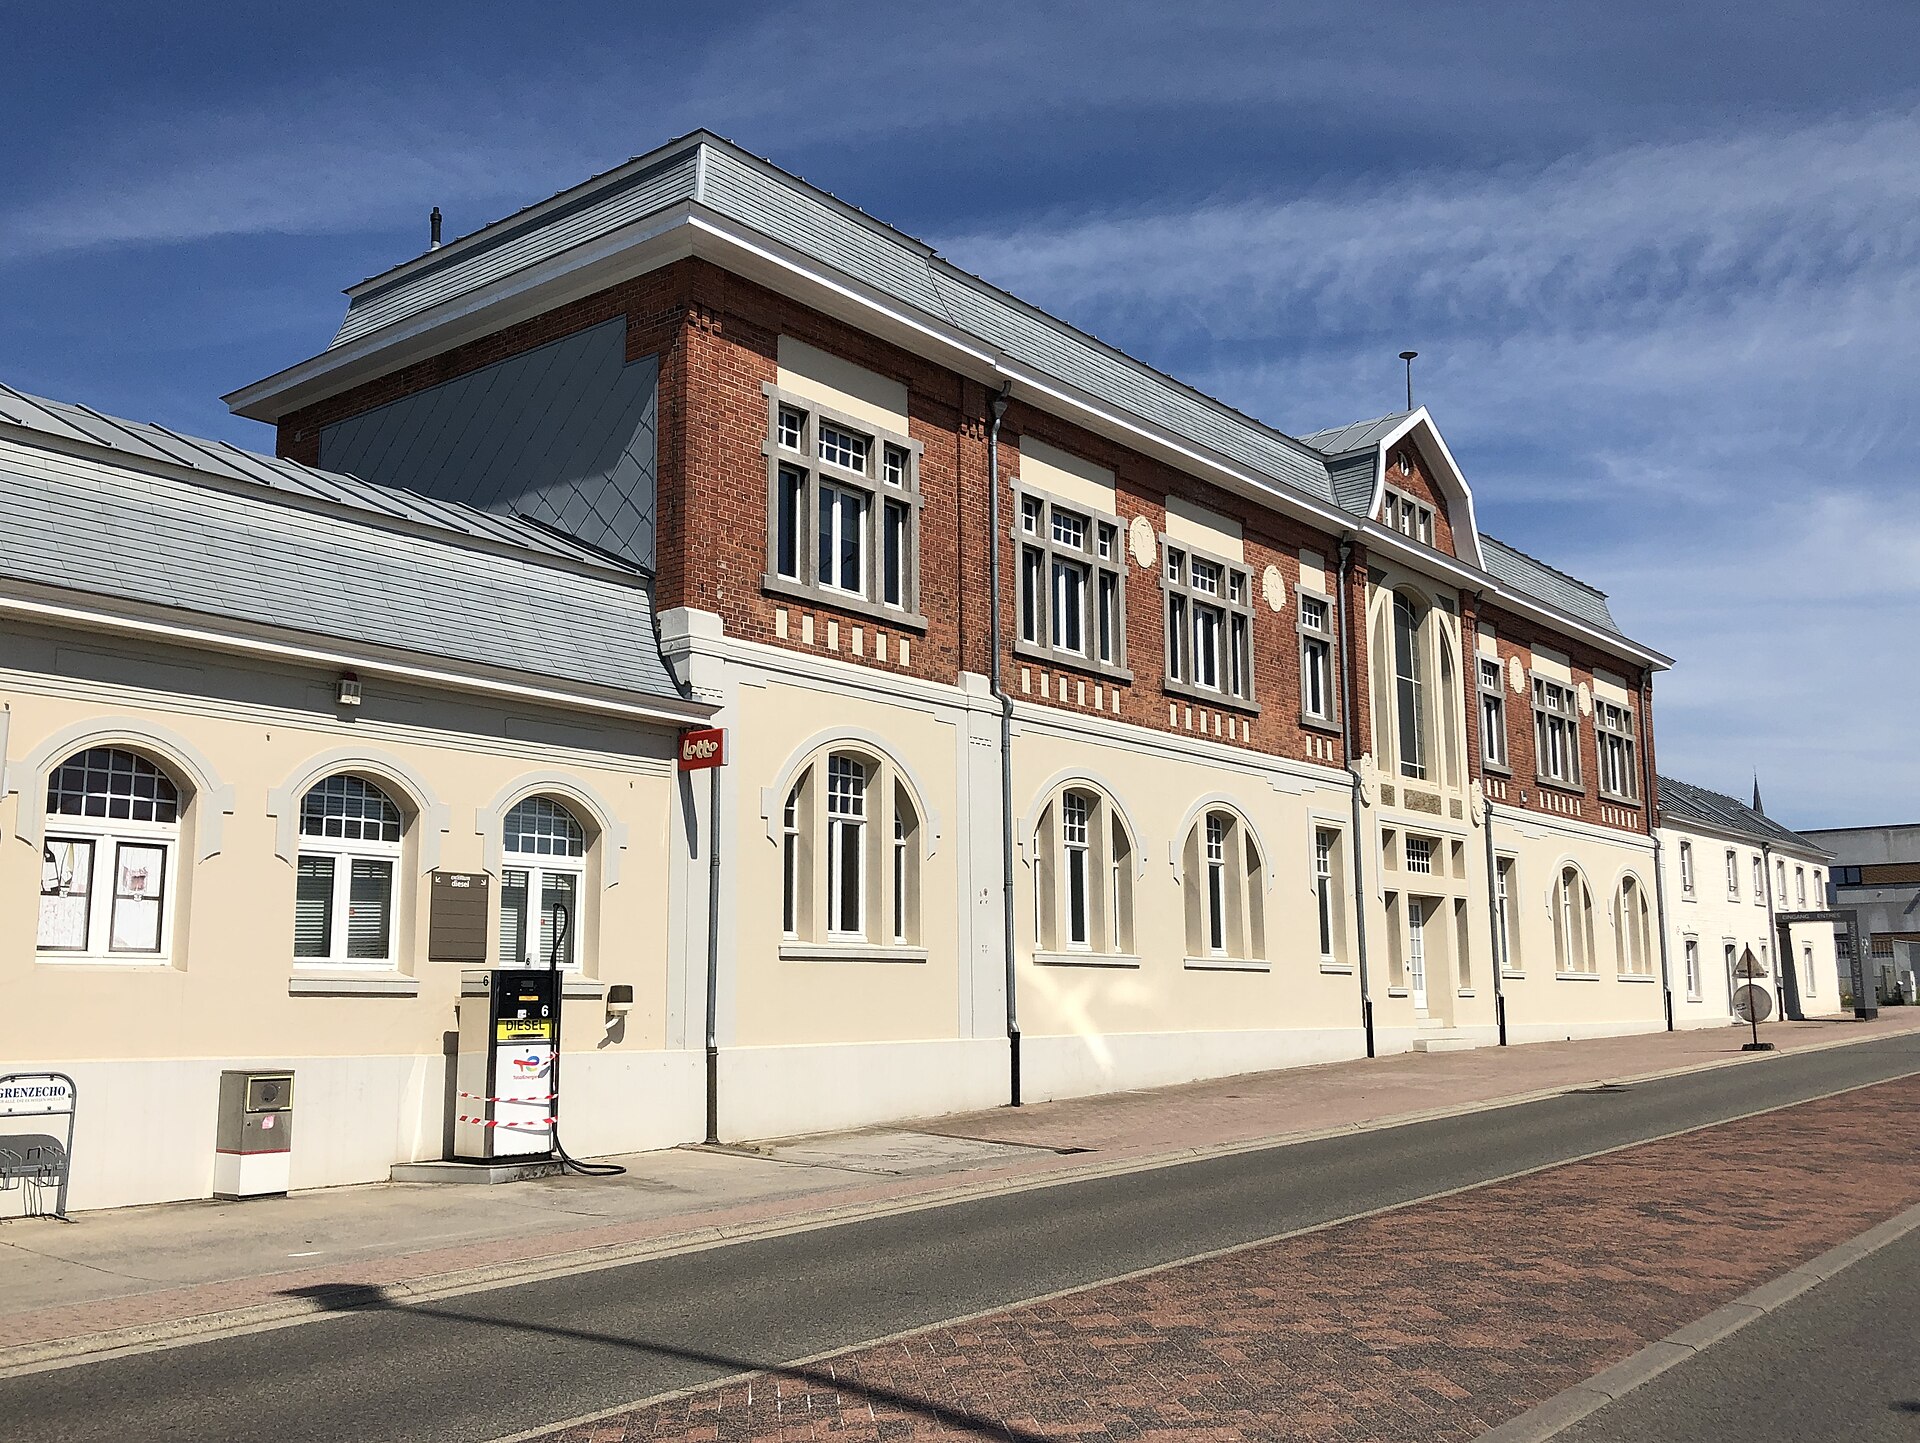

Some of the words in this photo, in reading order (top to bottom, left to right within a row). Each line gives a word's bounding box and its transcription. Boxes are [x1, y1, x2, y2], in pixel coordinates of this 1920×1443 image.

[525, 957, 531, 966] 6
[482, 975, 489, 986] 6
[541, 1004, 549, 1017] 6
[505, 1019, 545, 1031] DIESEL
